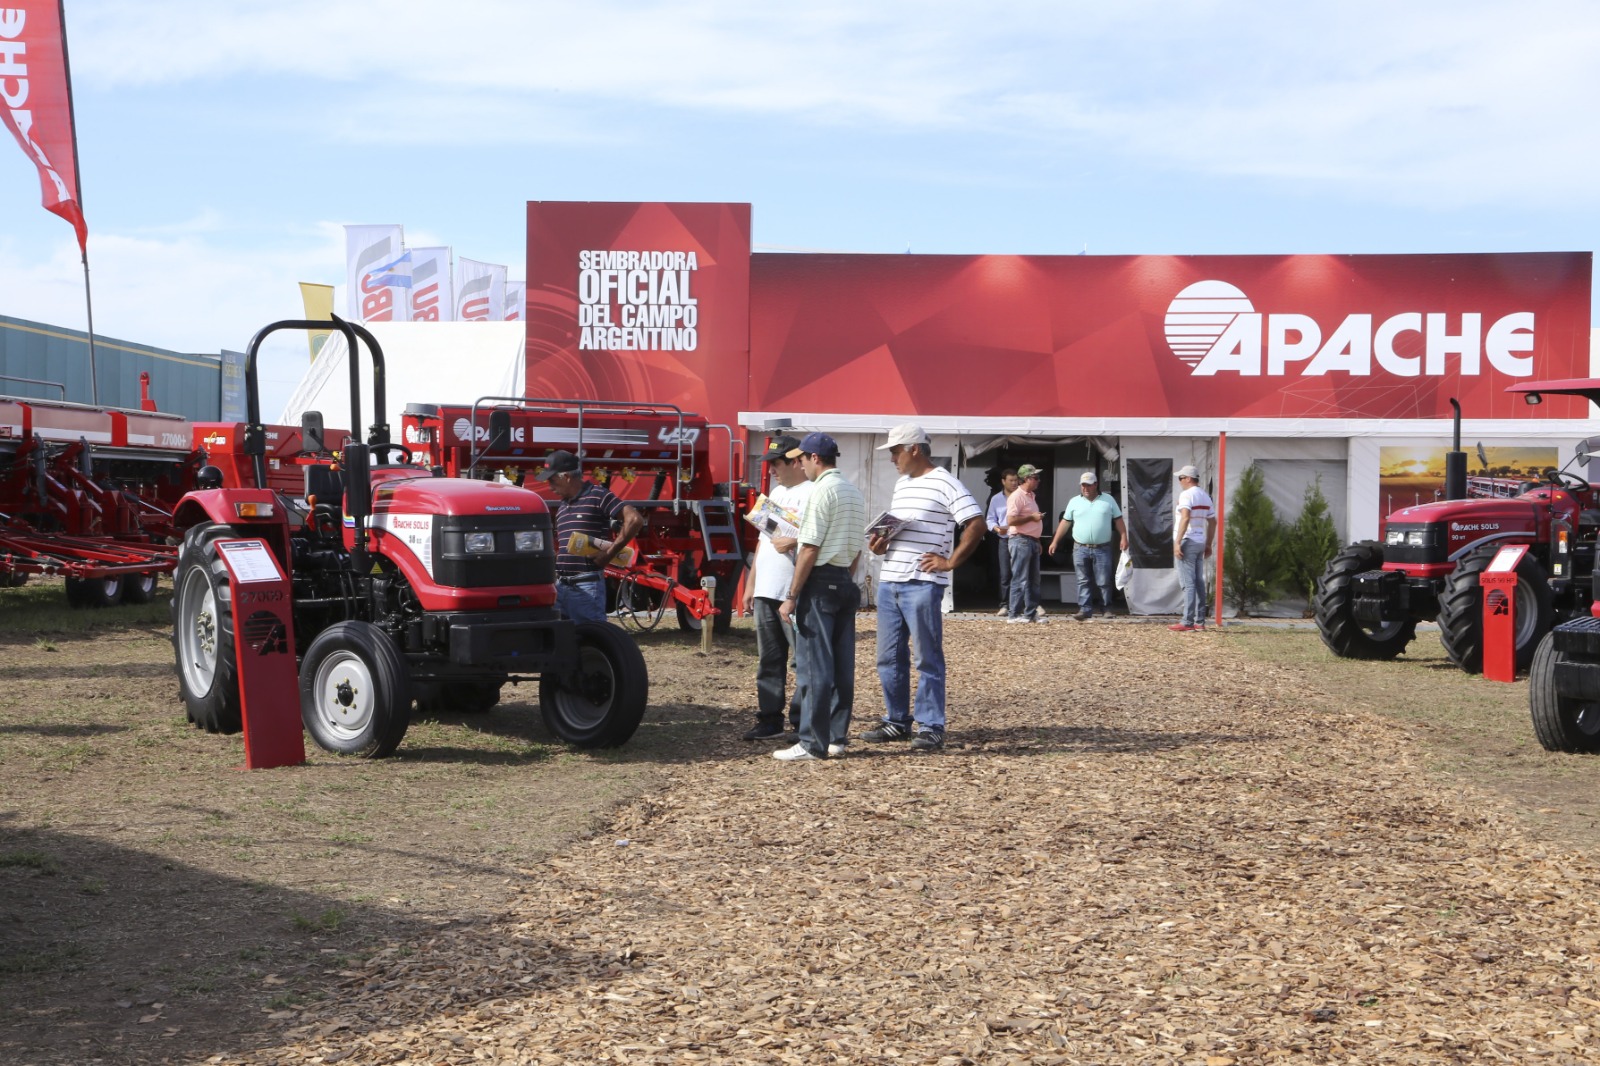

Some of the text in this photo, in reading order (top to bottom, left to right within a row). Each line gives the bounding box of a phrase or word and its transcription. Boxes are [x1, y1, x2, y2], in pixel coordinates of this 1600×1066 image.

[579, 250, 697, 271] SEMBRADORA
[579, 269, 697, 306] OFICIAL
[579, 304, 697, 328] DEL CAMPO
[579, 327, 697, 351] ARGENTINO
[1190, 312, 1535, 377] APACHE
[459, 425, 525, 442] APE
